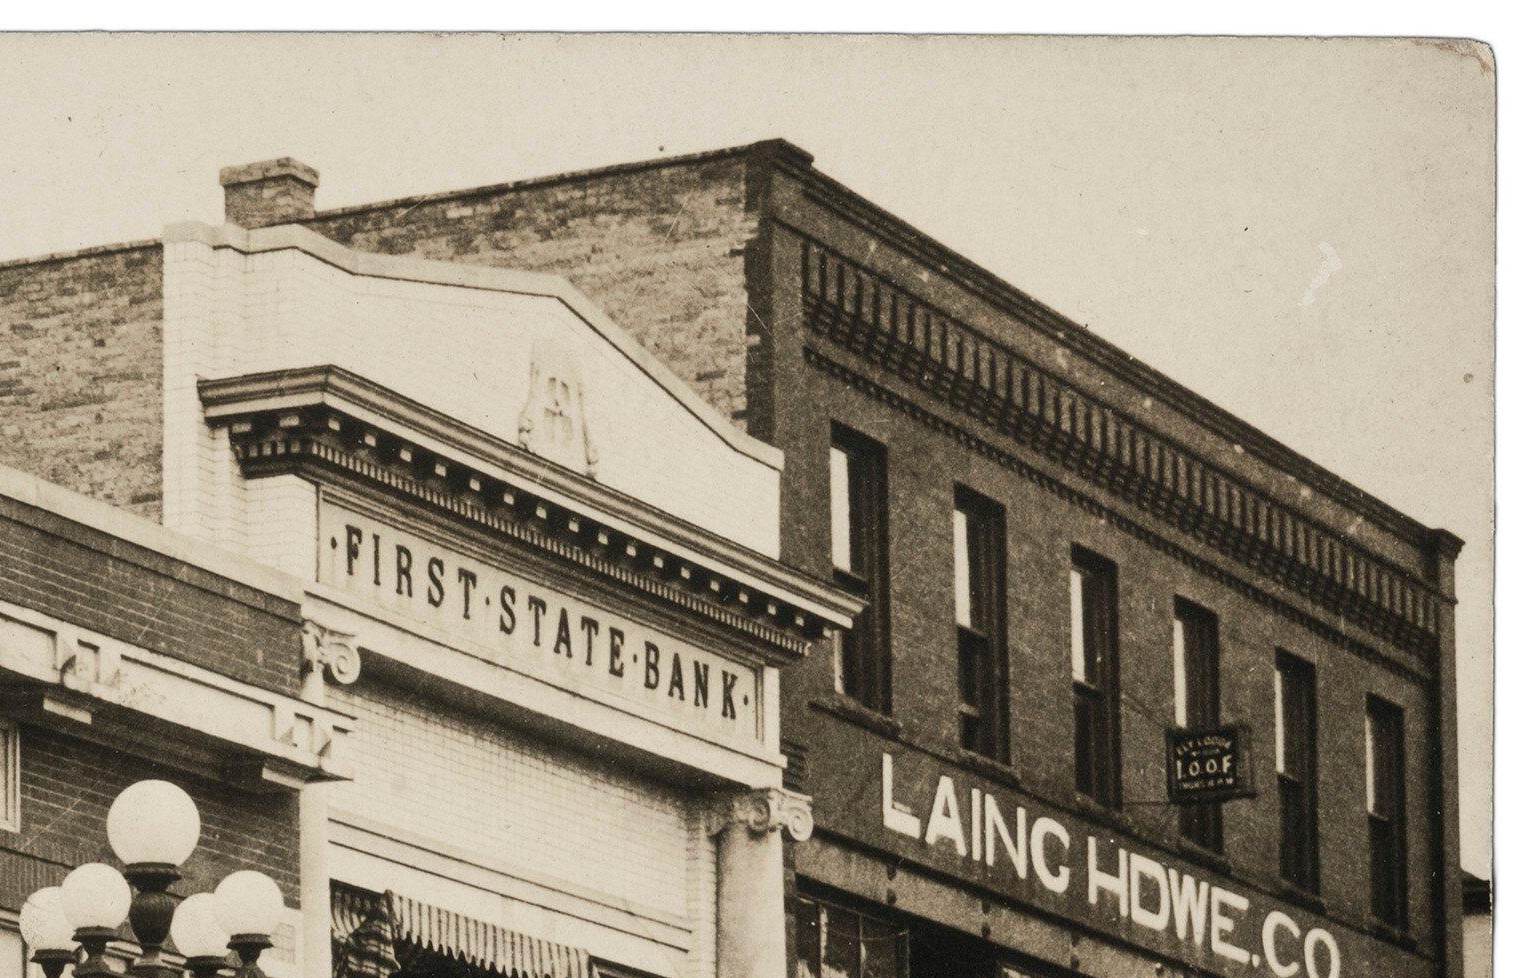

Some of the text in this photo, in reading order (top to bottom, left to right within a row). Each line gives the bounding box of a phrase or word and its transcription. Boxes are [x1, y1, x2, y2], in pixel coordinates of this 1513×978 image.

[344, 523, 739, 721] FIRST STATE BANK
[882, 753, 1071, 894] LAING
